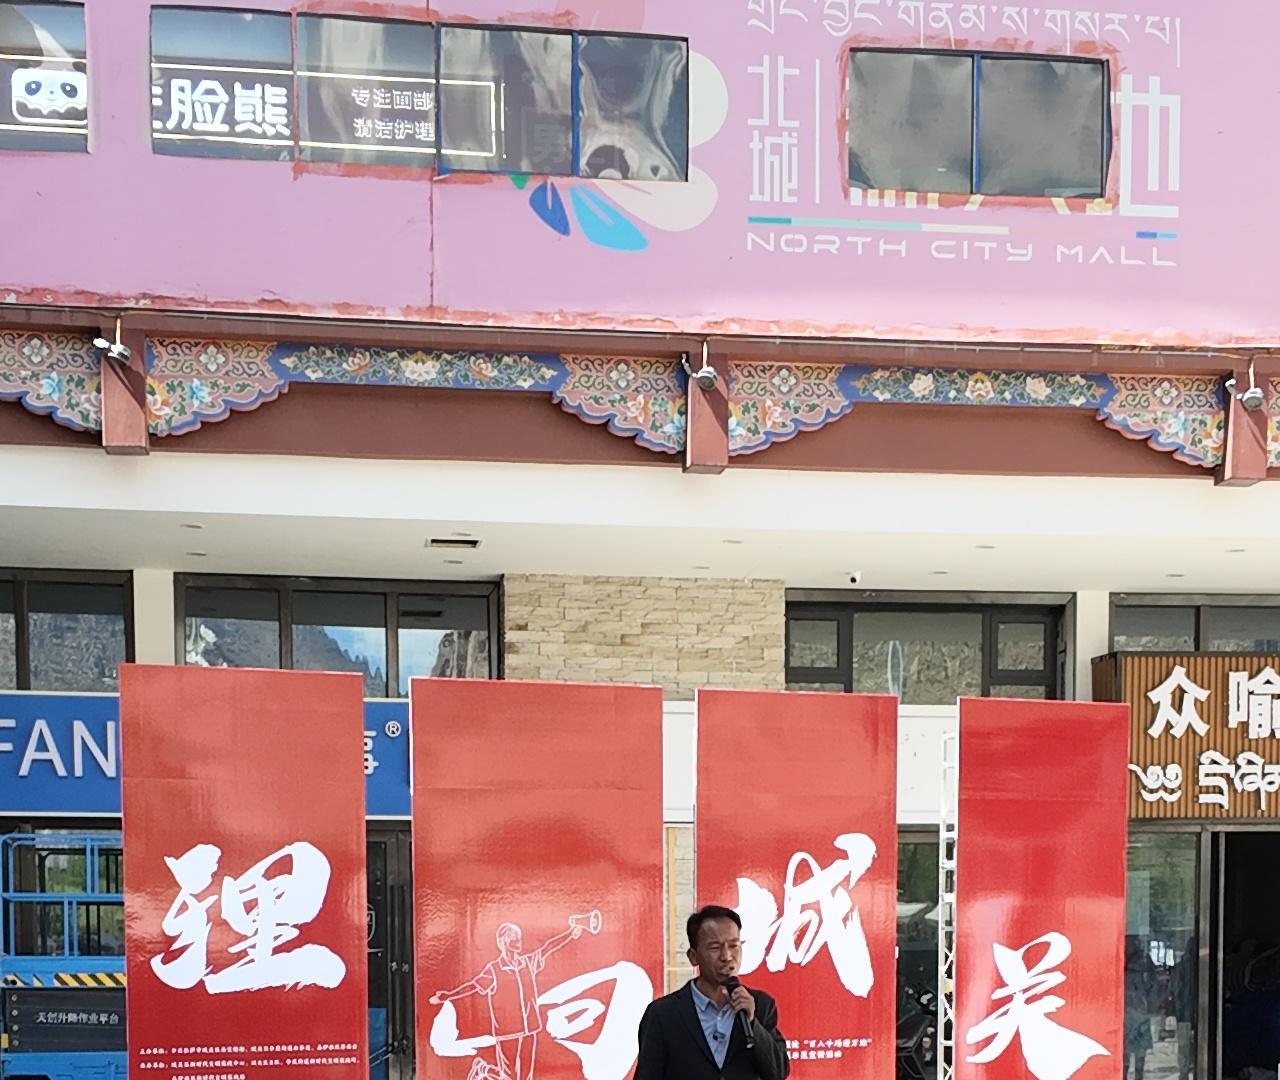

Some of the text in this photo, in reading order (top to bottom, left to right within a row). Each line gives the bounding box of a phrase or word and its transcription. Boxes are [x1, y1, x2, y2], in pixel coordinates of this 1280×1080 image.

[151, 78, 291, 137] 脸熊
[351, 87, 434, 111] 专注面部
[353, 117, 435, 142] 清洁护理
[746, 232, 1179, 267] NORTH CITY MALL
[734, 832, 878, 999] 城
